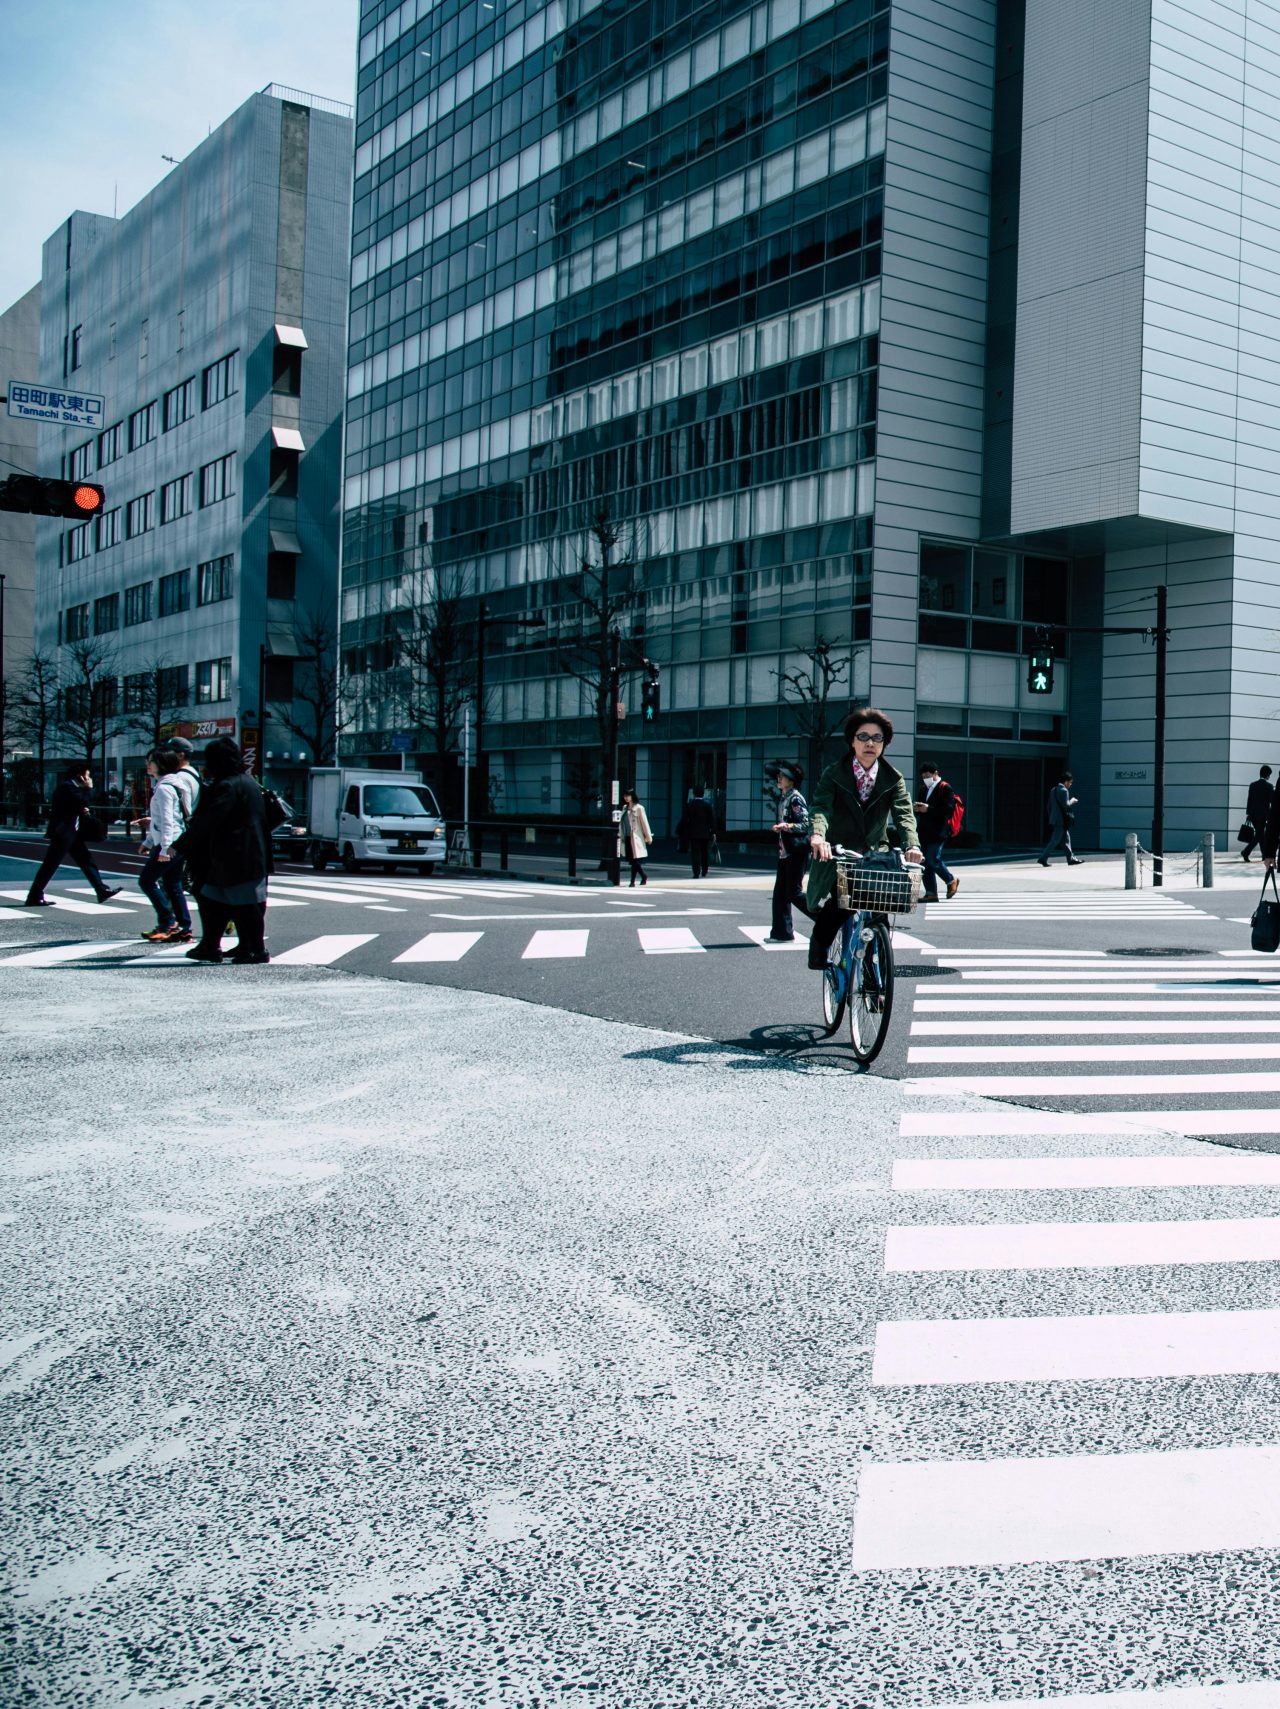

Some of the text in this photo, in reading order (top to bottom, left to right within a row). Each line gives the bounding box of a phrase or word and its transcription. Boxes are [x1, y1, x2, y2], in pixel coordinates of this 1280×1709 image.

[13, 386, 101, 414] 田町駅東口
[17, 404, 96, 425] Tamachi Sta.-E.
